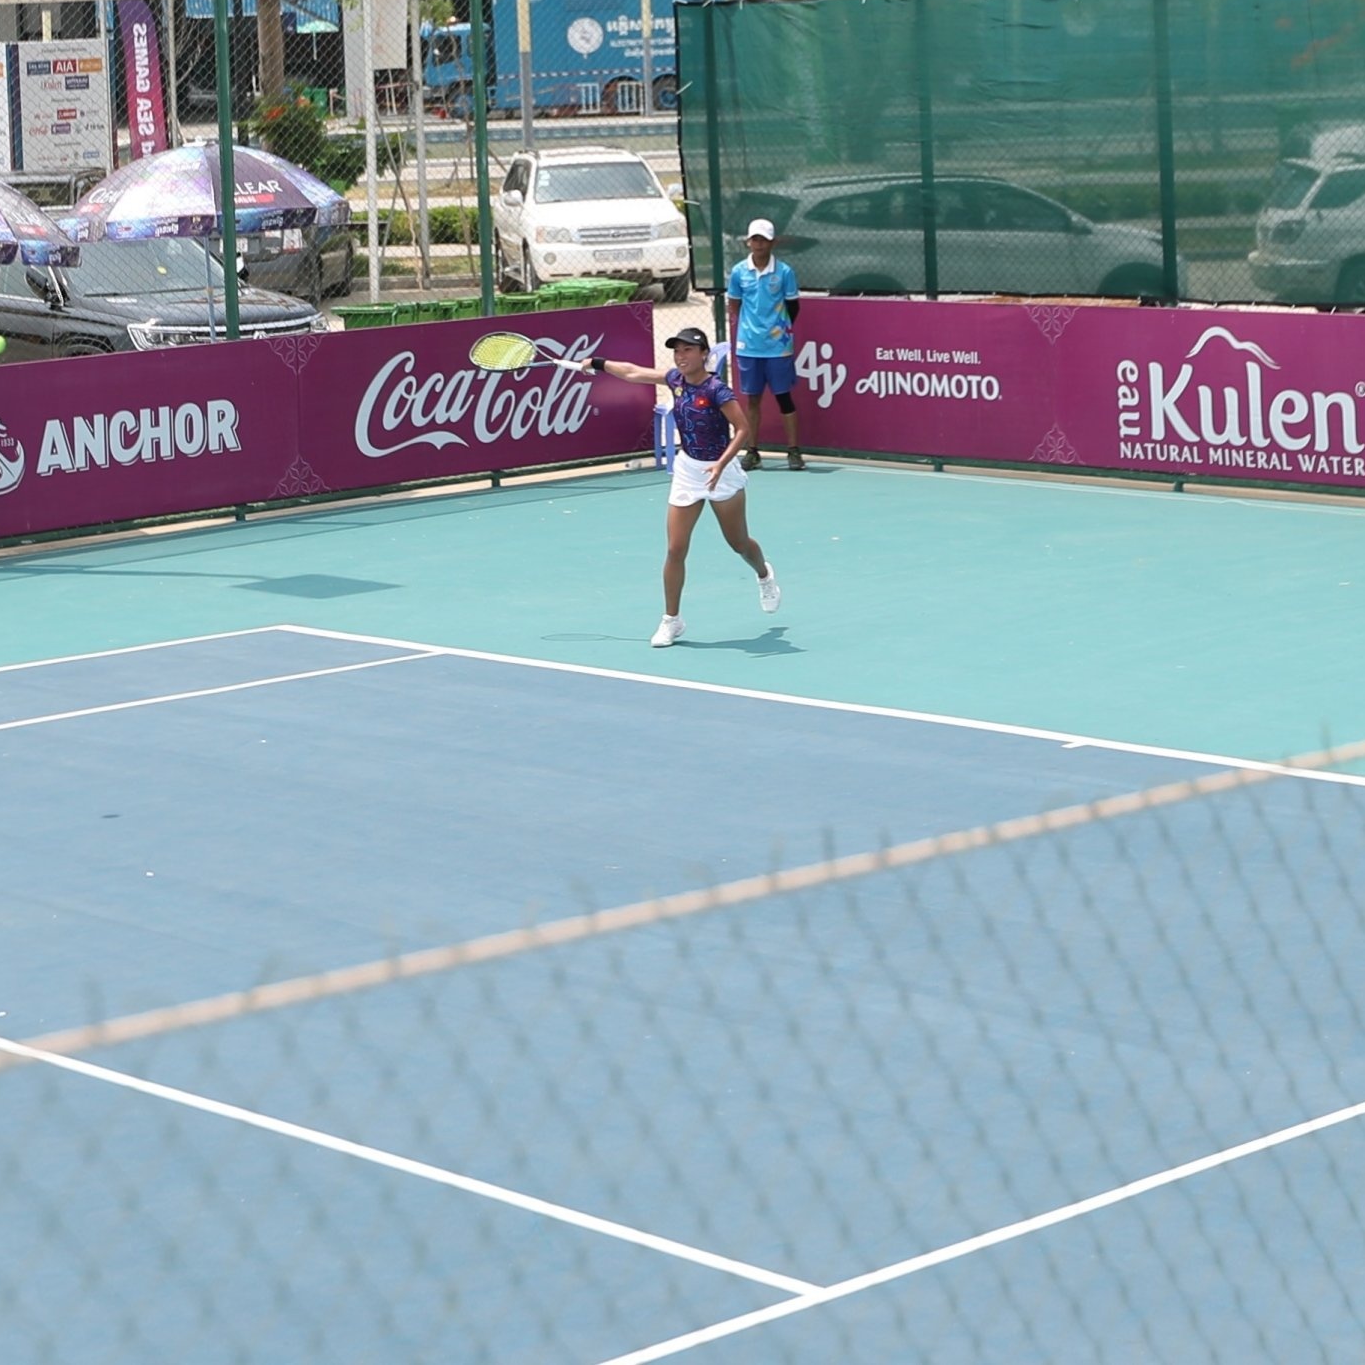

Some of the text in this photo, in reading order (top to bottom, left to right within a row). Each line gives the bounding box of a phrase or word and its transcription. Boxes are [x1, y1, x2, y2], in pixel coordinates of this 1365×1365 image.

[56, 61, 73, 73] AIA
[234, 180, 283, 195] LEAR
[875, 347, 981, 365] Eat Well, Live Well.
[1116, 360, 1141, 438] eau
[1148, 361, 1365, 454] Kulen
[37, 399, 241, 476] ANCHOR
[1119, 442, 1203, 464] NATURAL
[1208, 447, 1293, 471] MINERAL
